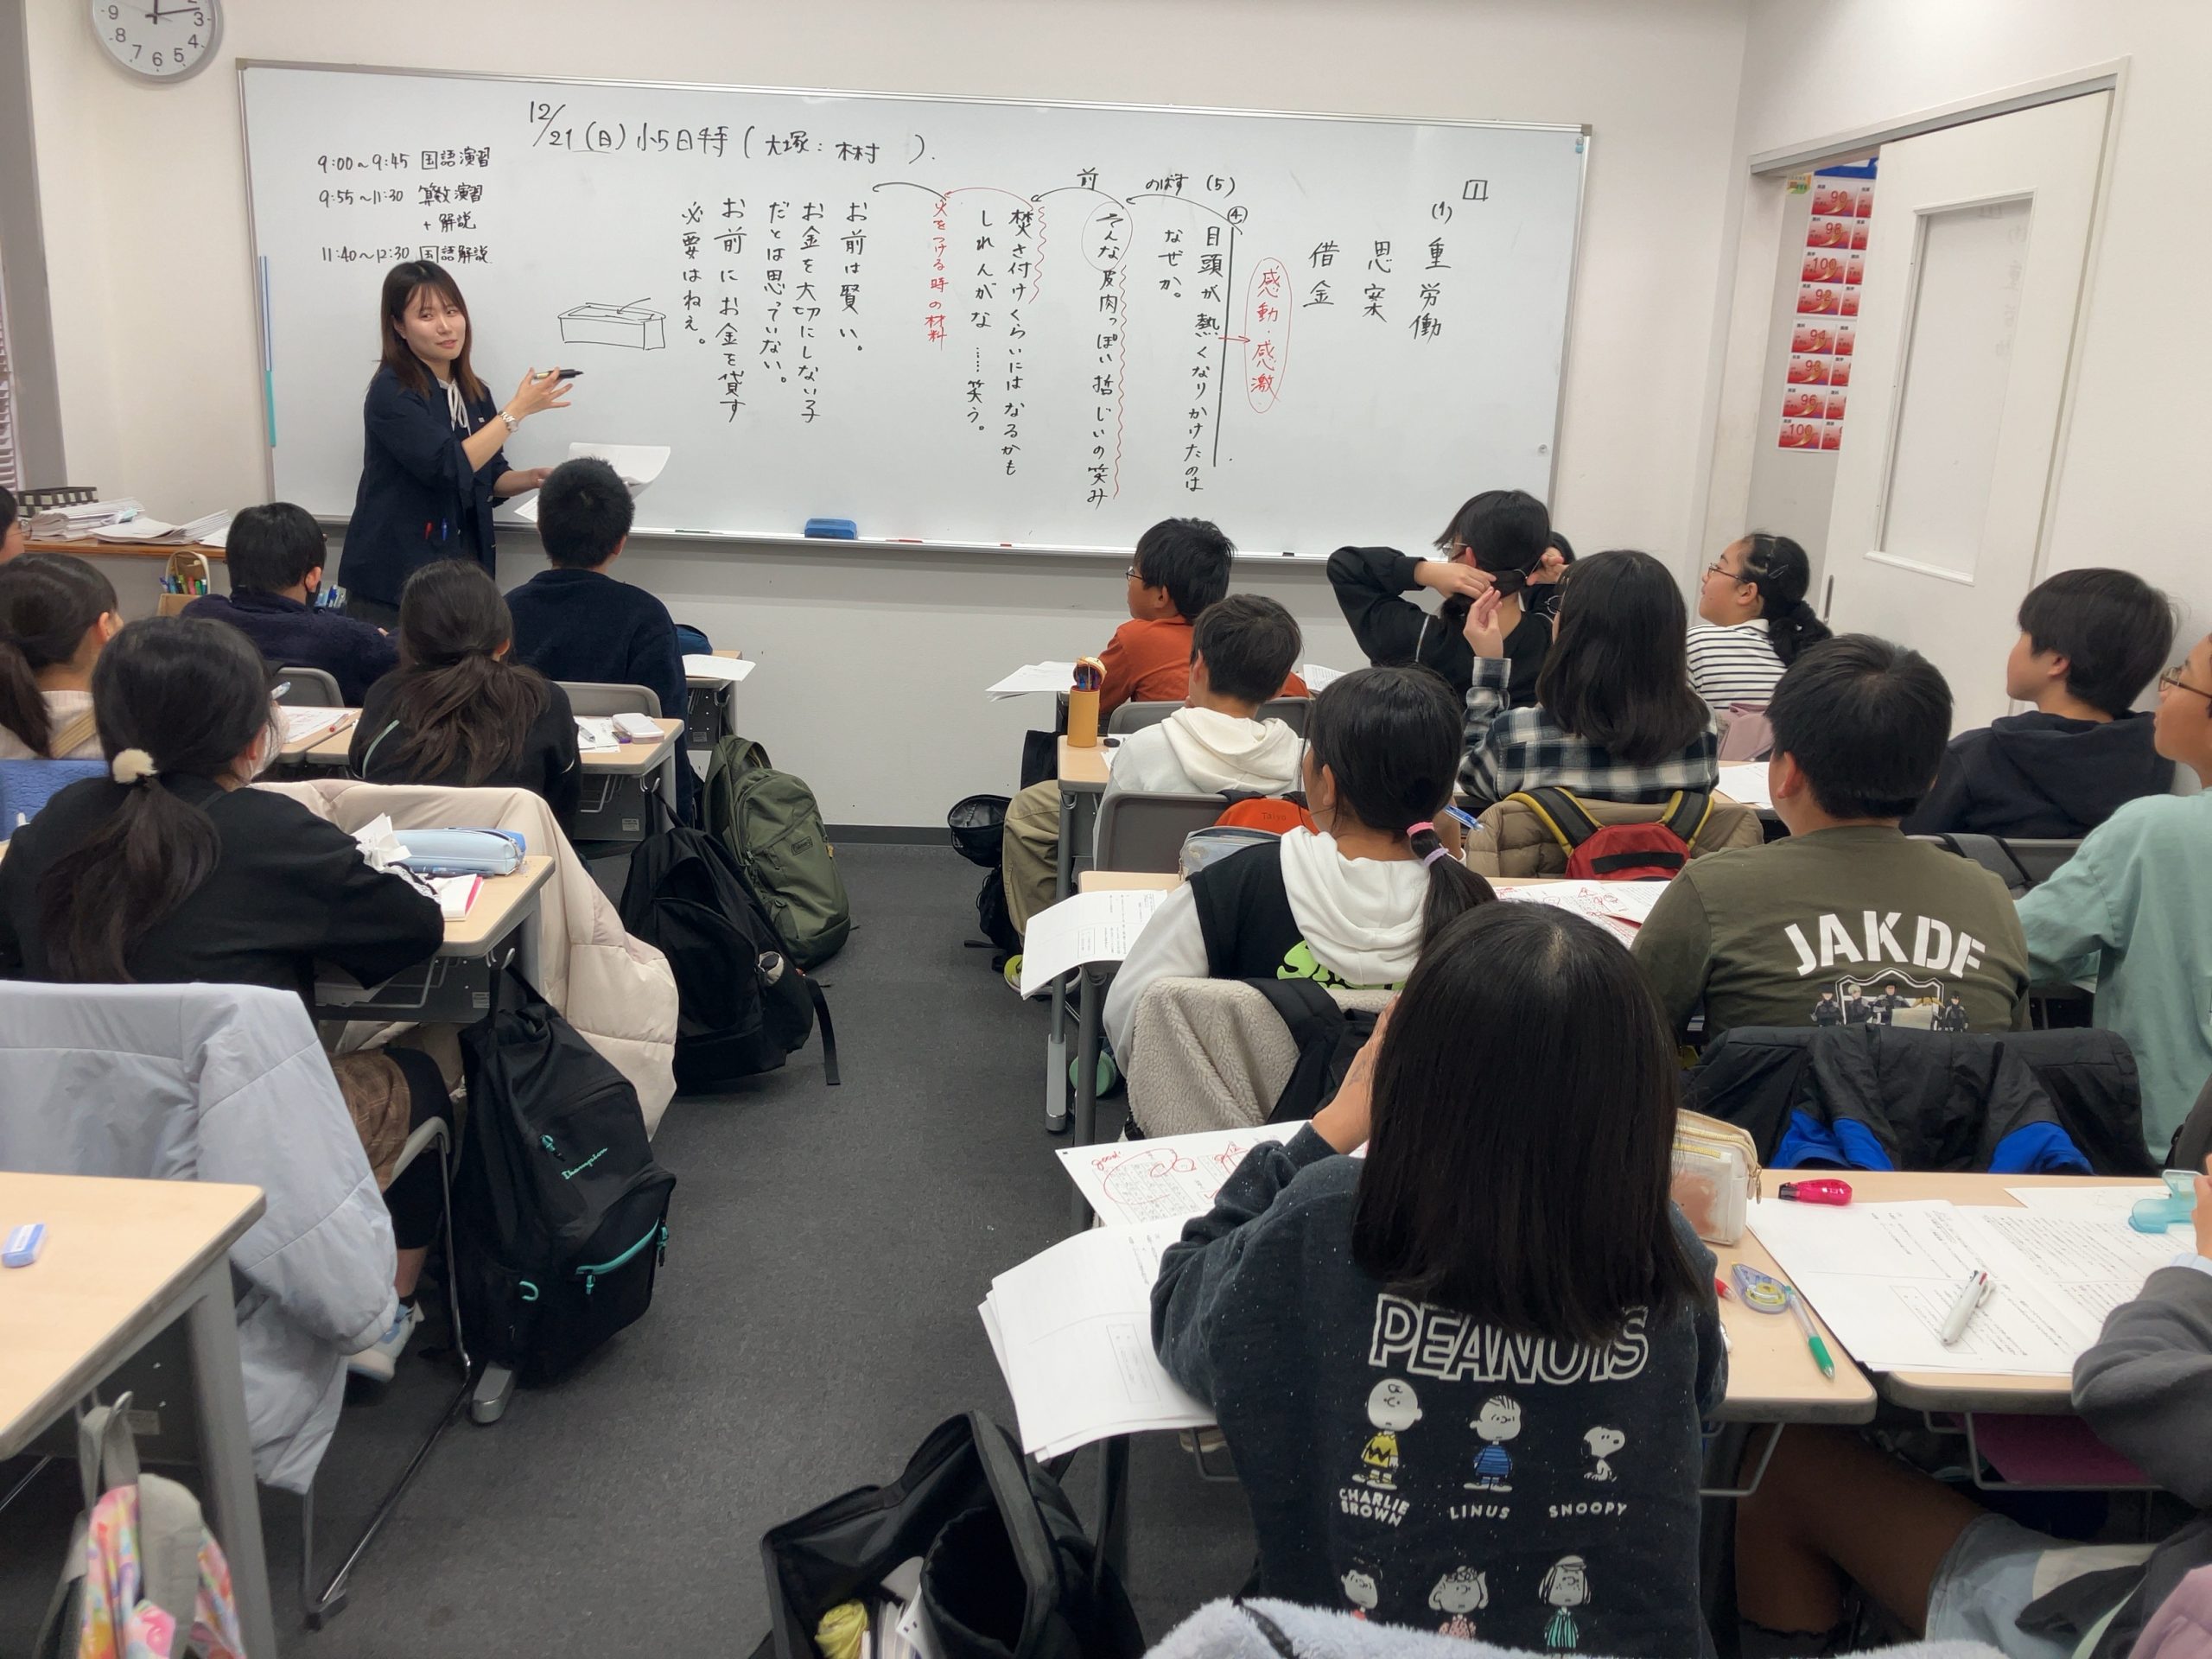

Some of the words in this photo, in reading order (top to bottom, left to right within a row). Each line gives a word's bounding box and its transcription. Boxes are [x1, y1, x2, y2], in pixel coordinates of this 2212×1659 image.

[108, 5, 118, 20] 9
[194, 11, 204, 27] 3
[115, 28, 126, 42] 8
[188, 34, 199, 48] 4
[132, 44, 142, 60] 7
[152, 52, 162, 67] 6
[174, 48, 184, 63] 5
[421, 146, 491, 170] 国語演習
[1077, 168, 1100, 190] 前
[1145, 174, 1189, 196] のばす
[1206, 175, 1236, 199] (5)
[418, 182, 483, 207] 算数演習
[1831, 190, 1847, 203] 90
[438, 211, 476, 232] 解説
[1431, 200, 1452, 224] (1)
[419, 245, 488, 264] 国語解説
[1158, 229, 1184, 298] なぜか。
[1813, 257, 1837, 270] 100
[925, 199, 950, 351] 火をつける時の材料
[1303, 240, 1340, 308] 借金
[1363, 240, 1392, 323] 思案
[760, 201, 790, 383] だとは思っていない。
[1408, 237, 1452, 344] 重労働
[714, 198, 747, 423] お前にお金を貸す
[792, 202, 824, 423] お金を大切にしない子
[1185, 226, 1223, 492] 目頭が熱くなりかけたのは
[1789, 423, 1813, 436] 100
[1783, 910, 1986, 979] JAKDF
[1338, 1487, 1410, 1516] CHARLIE
[1449, 1503, 1511, 1521] LINUS
[1548, 1502, 1628, 1519] SNOOPY
[1340, 1499, 1402, 1528] BROWN
